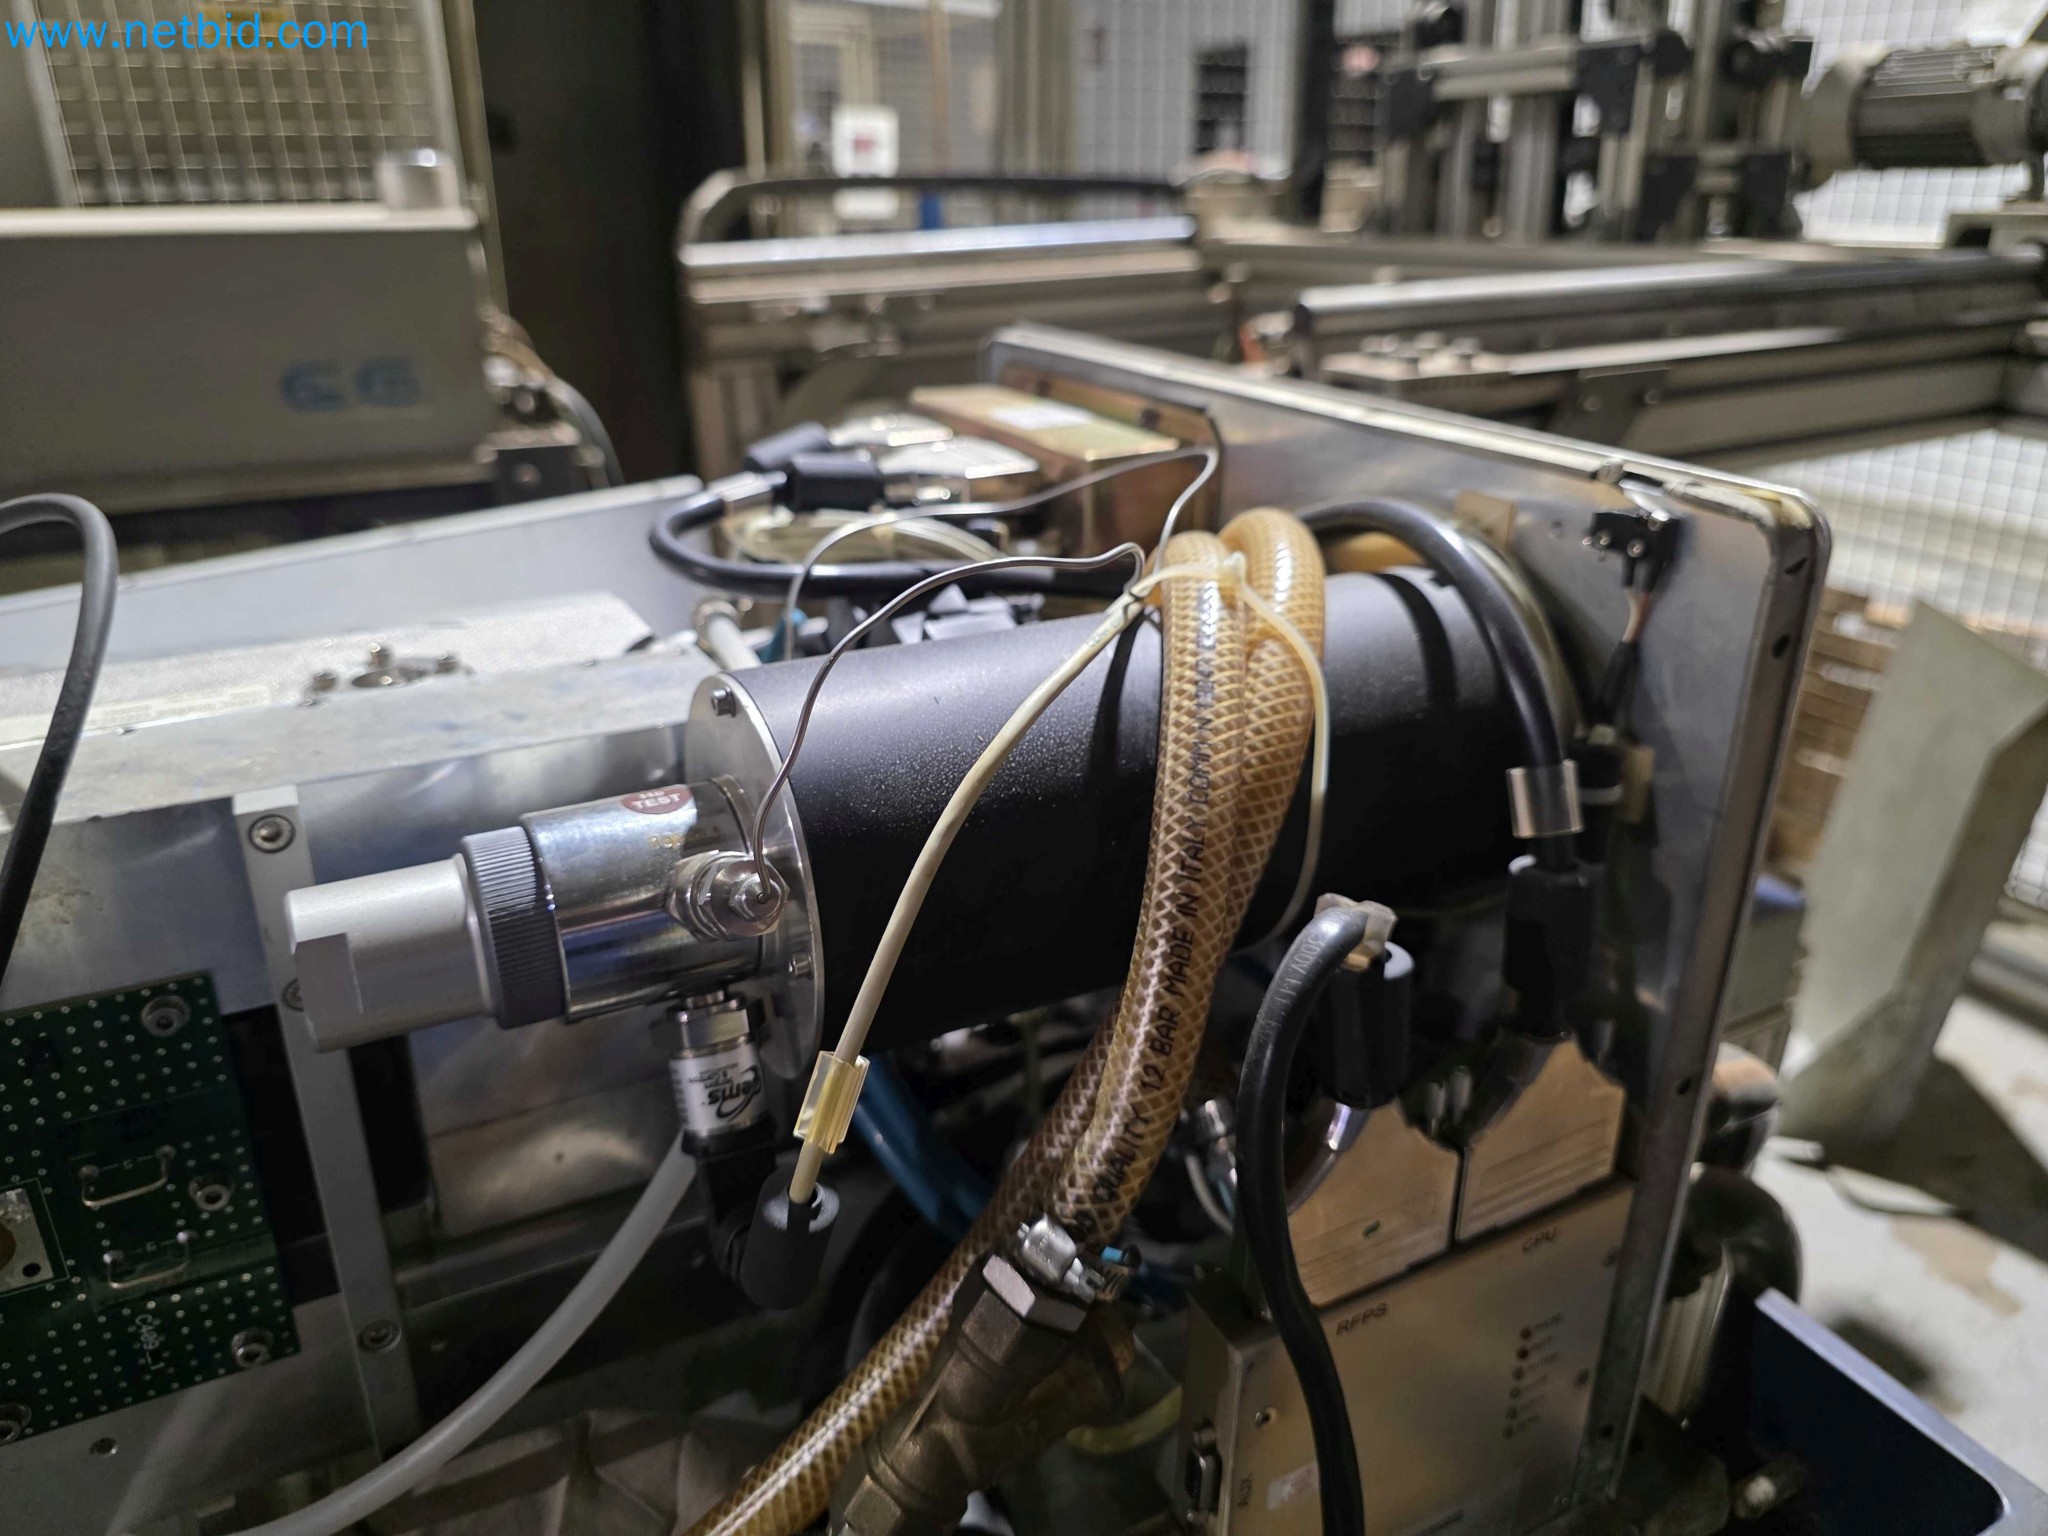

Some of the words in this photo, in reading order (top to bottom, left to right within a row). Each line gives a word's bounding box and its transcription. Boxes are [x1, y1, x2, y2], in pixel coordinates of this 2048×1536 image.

[1194, 717, 1212, 732] N
[1189, 740, 1212, 805] COMM
[631, 792, 681, 809] TEST
[1177, 816, 1207, 883] ITALY
[1176, 890, 1200, 919] IN
[1165, 927, 1196, 997] MADE
[1150, 1005, 1181, 1057] BAR
[1141, 1063, 1166, 1092] 12
[1092, 1101, 1150, 1203] QUALITY
[1521, 1228, 1557, 1252] CPU
[1335, 1303, 1387, 1336] RFPS
